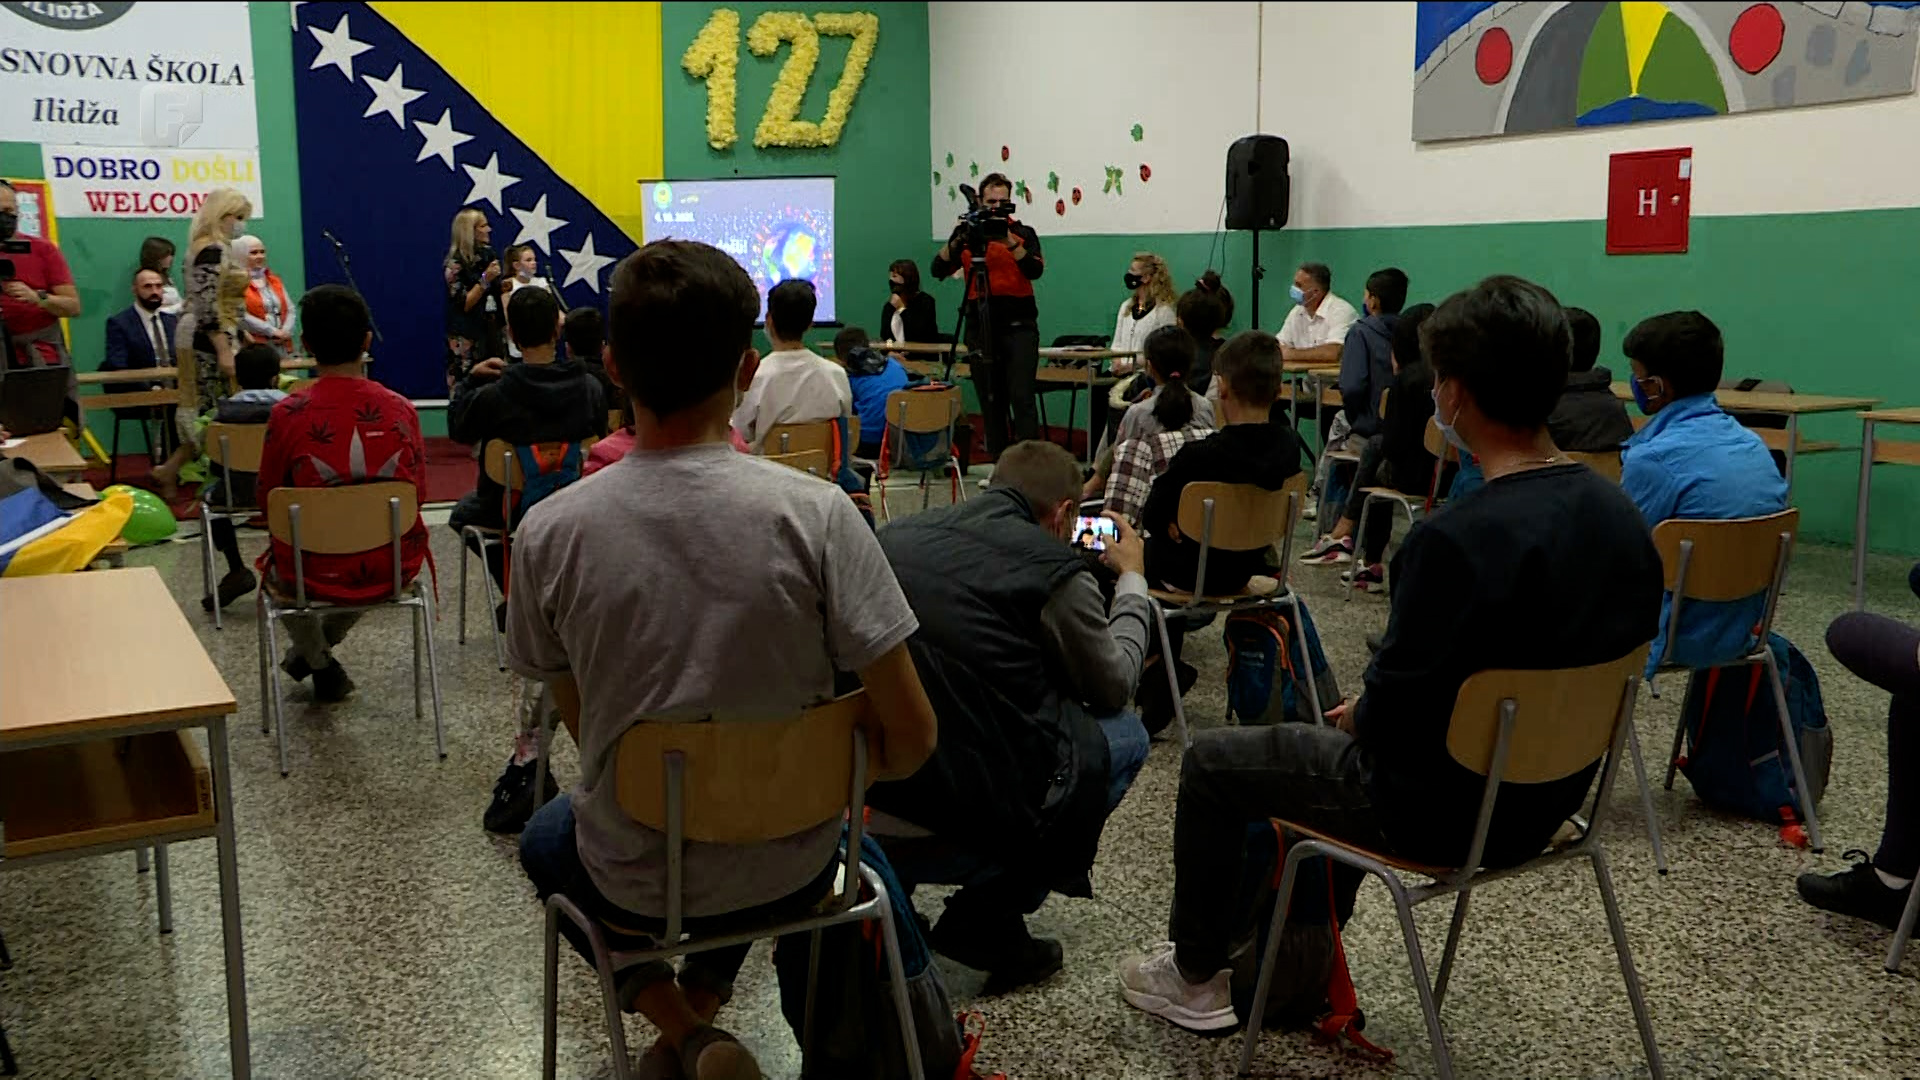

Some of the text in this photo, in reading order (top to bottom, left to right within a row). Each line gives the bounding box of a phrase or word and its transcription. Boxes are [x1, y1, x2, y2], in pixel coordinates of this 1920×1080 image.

[0, 47, 245, 86] SNOVNA ŠKOLA
[680, 8, 879, 150] 127
[33, 97, 119, 126] Ilidža
[53, 155, 255, 183] DOBRO DOŠLI
[84, 191, 209, 214] WELCOM
[1638, 187, 1658, 216] H
